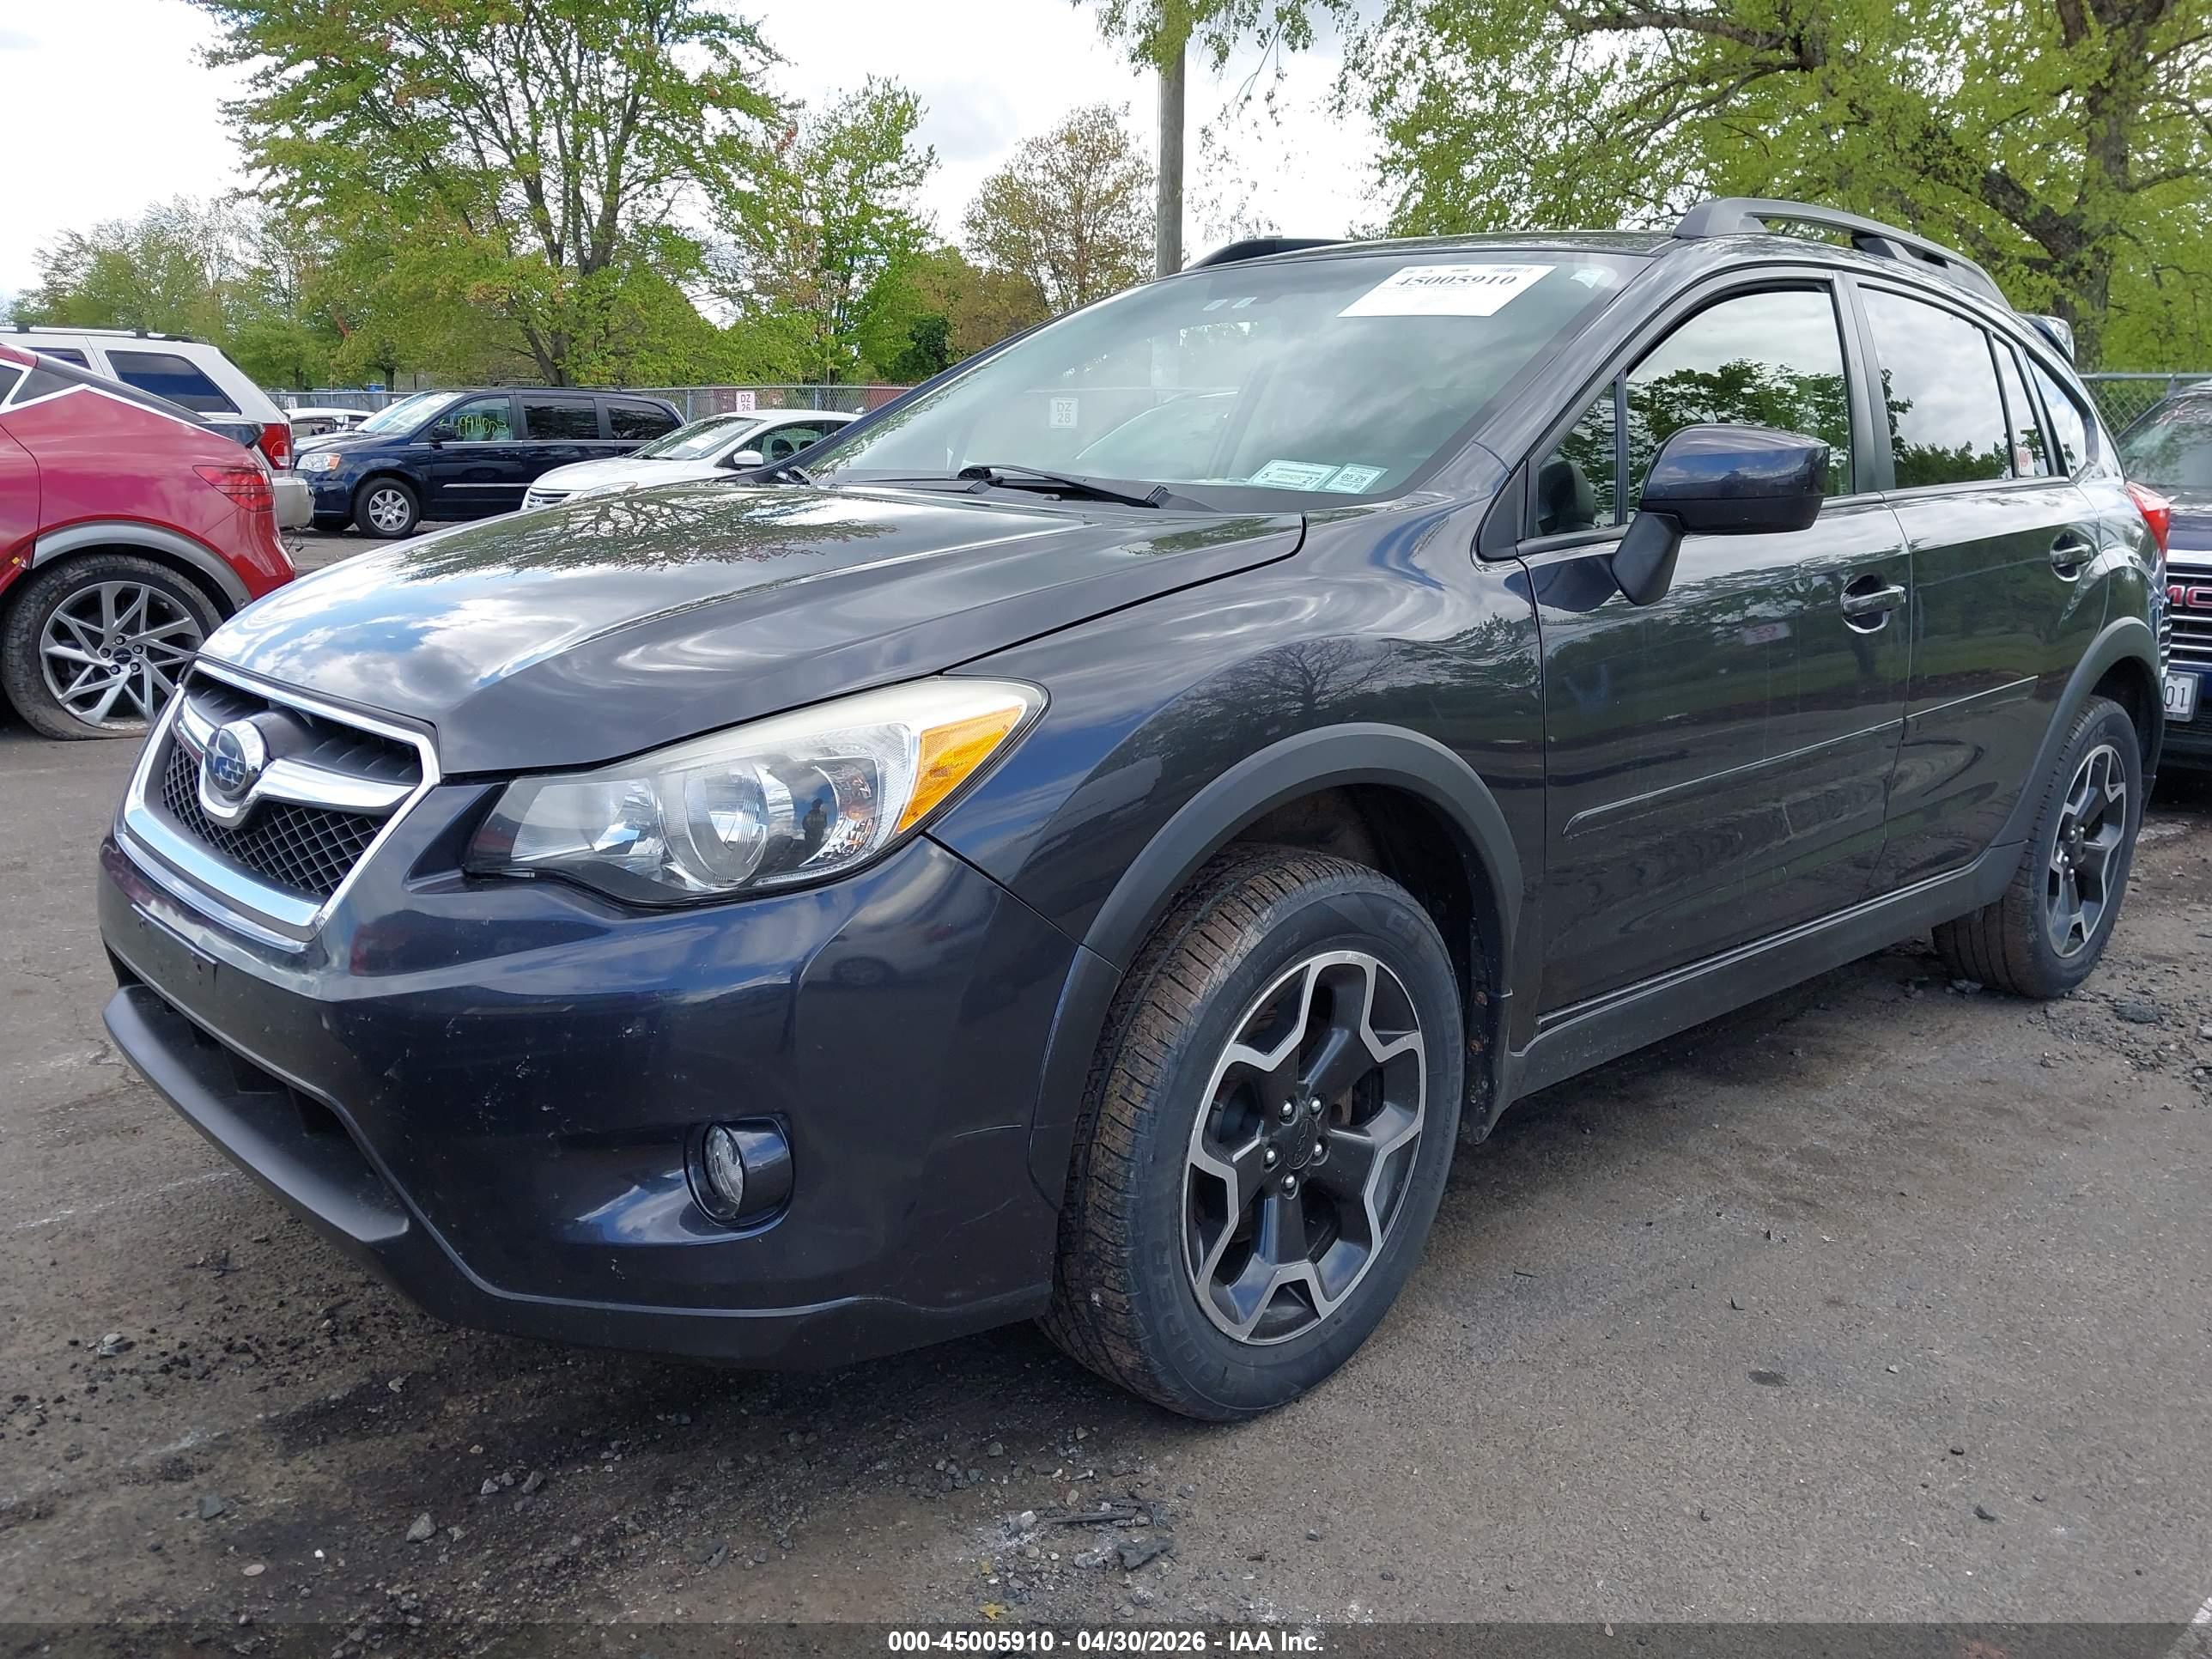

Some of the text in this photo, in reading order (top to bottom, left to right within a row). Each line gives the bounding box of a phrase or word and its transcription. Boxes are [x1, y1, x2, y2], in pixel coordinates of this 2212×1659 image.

[1395, 275, 1518, 286] 45005910
[740, 393, 751, 403] DZ
[741, 404, 751, 412] 26
[1056, 402, 1073, 413] DZ
[1057, 413, 1072, 423] 28
